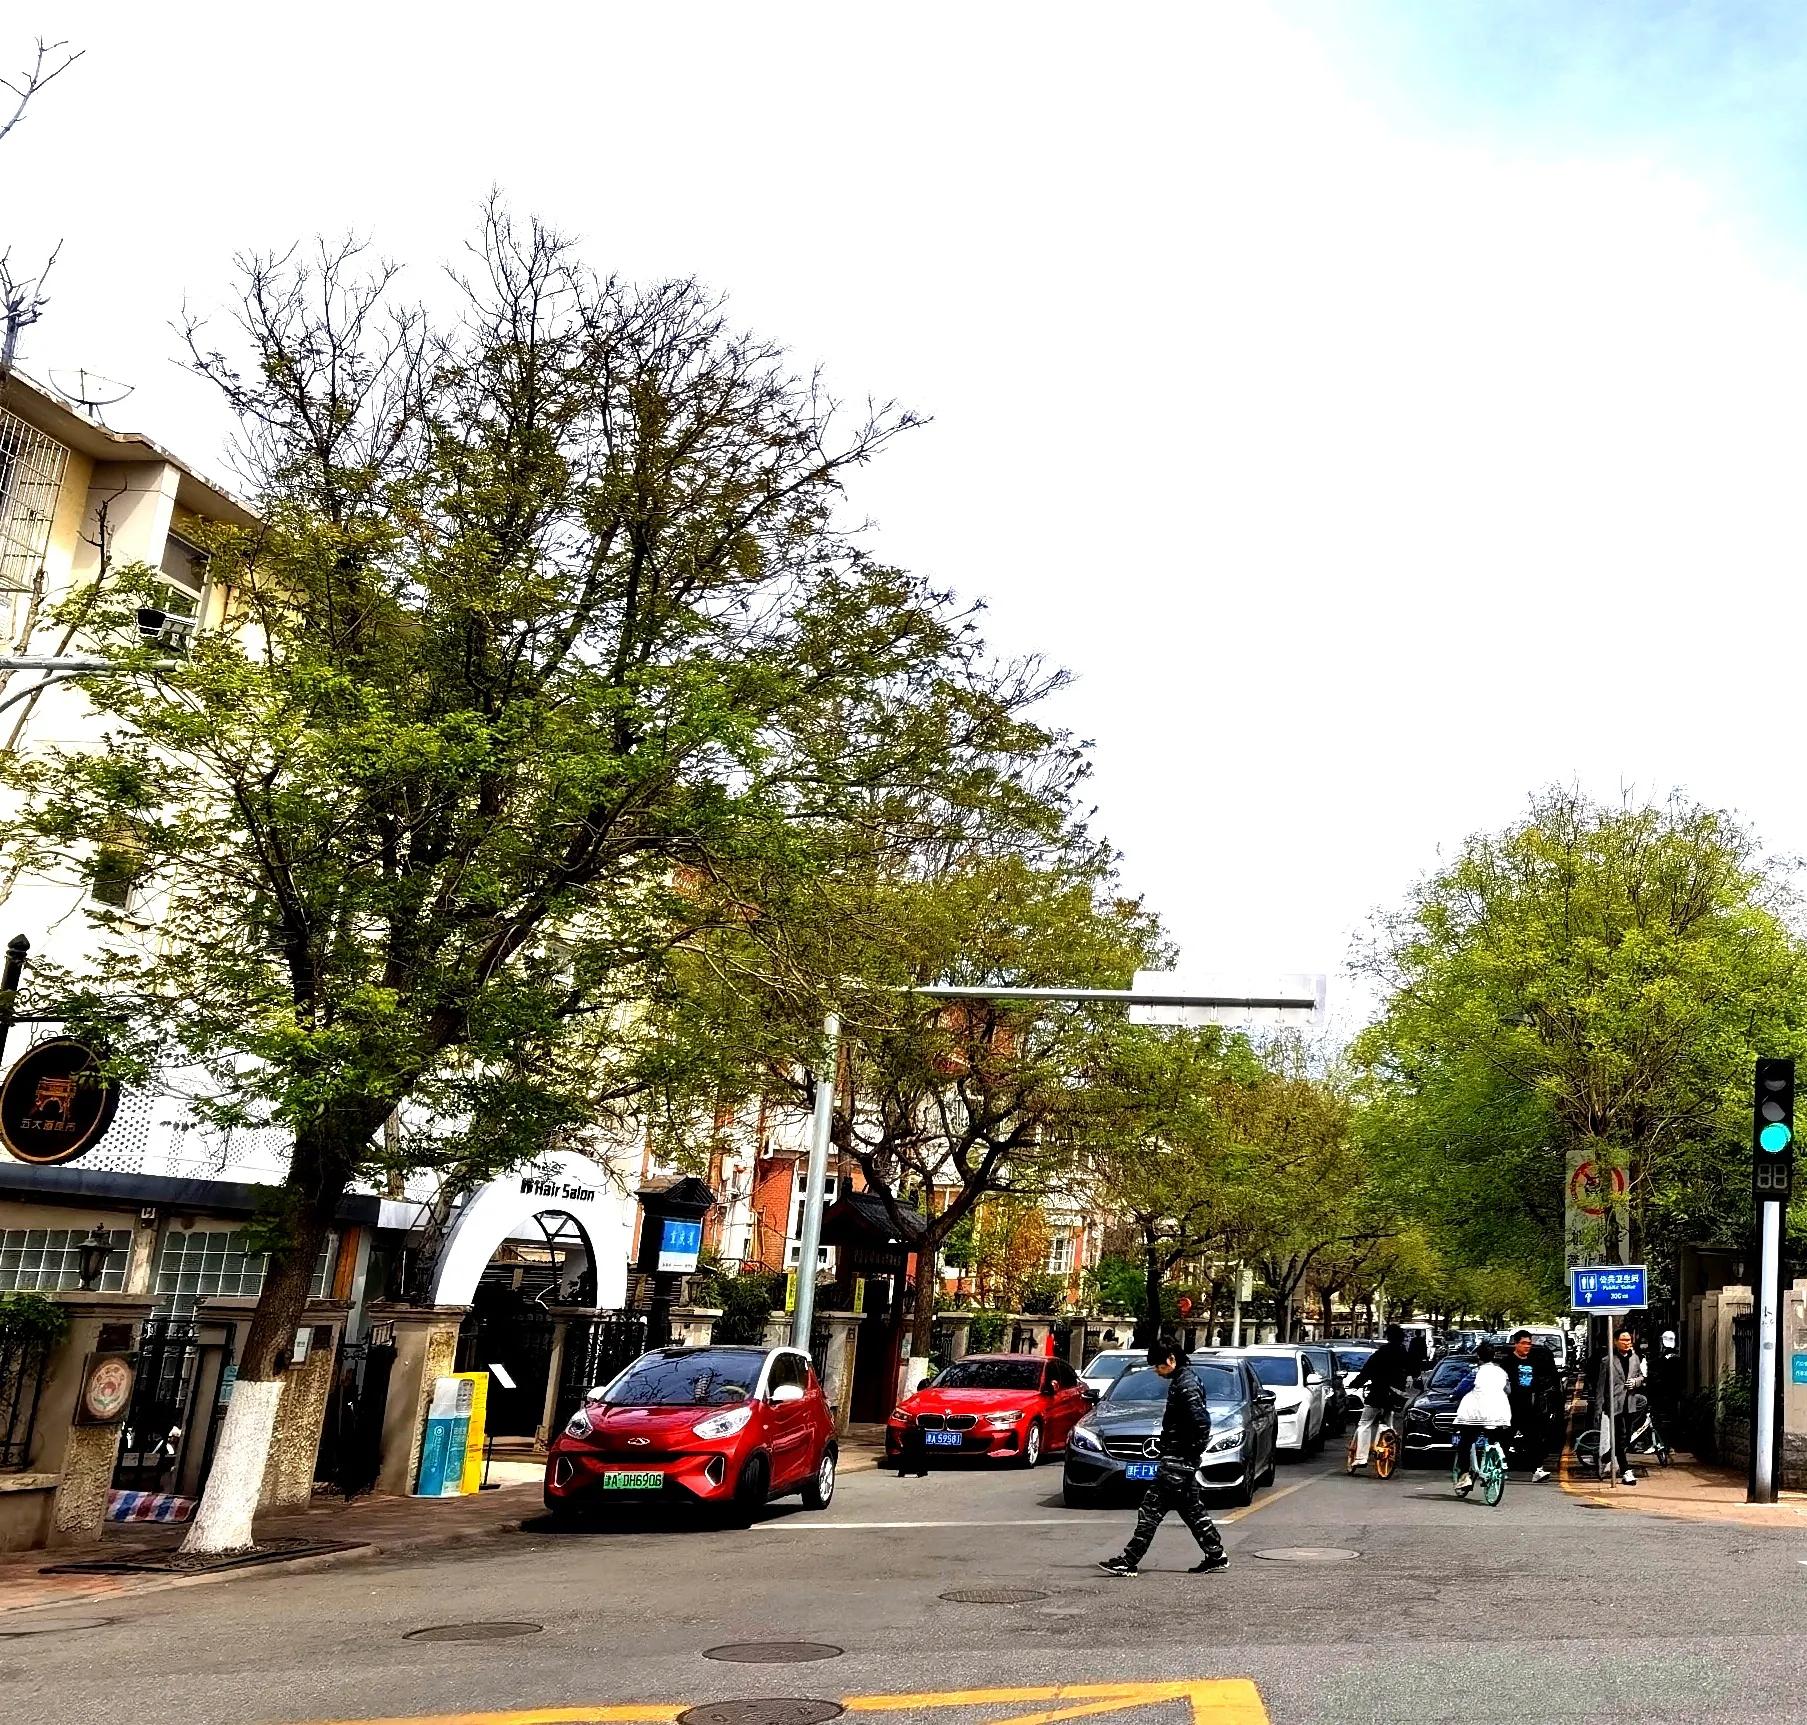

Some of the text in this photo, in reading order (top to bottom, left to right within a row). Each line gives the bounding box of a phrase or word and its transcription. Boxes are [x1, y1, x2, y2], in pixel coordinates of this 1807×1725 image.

[534, 1180, 561, 1198] Hair
[562, 1184, 596, 1202] Salon
[1599, 1274, 1640, 1284] 公共卫生间
